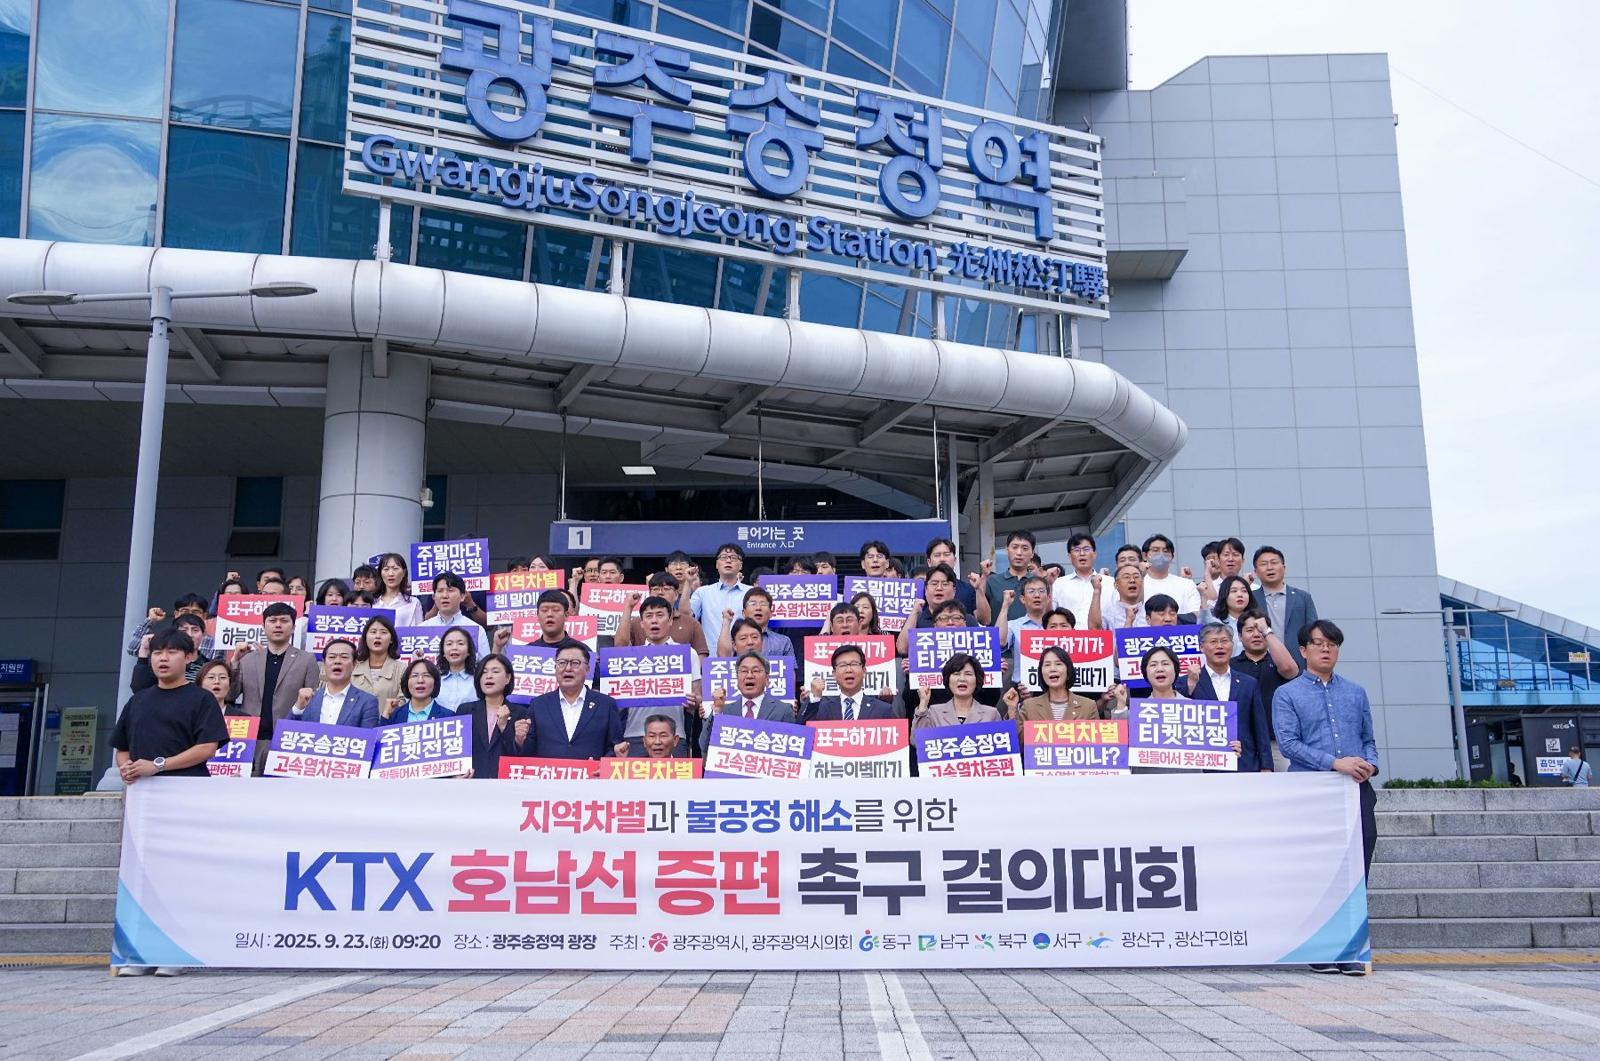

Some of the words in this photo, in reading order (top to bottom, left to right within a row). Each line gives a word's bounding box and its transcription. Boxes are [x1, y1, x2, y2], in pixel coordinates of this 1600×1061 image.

[440, 0, 1053, 241] 광주송정역
[361, 134, 797, 256] GwangjuSongjeong
[807, 216, 938, 271] Station
[576, 528, 584, 546] 1
[738, 526, 785, 540] 들어가는
[792, 526, 804, 540] 곳
[417, 542, 482, 561] 주말마다
[747, 541, 777, 549] Entrance
[418, 558, 483, 577] 티켓전쟁
[494, 572, 558, 591] 지역차별
[766, 584, 832, 599] 광주송정역
[851, 580, 917, 598] 주말마다
[510, 592, 540, 607] 말이
[916, 631, 992, 650] 주말마다
[512, 654, 556, 674] 광주송
[608, 655, 683, 675] 광주송정역
[608, 678, 684, 697] 고속열차증편
[1139, 703, 1228, 726] 주말마다
[381, 720, 463, 746] 주말마다
[720, 726, 806, 757] 광주송정역
[816, 726, 900, 747] 표구하기가
[1034, 722, 1120, 743] 지역차별
[1139, 723, 1228, 747] 티켓전쟁
[281, 731, 367, 758] 광주송정역
[381, 737, 463, 764] 티켓전쟁
[925, 732, 1012, 759] 광주송정역
[715, 751, 802, 778] 고속열차증편
[1034, 746, 1052, 766] 웬
[1055, 746, 1121, 766] 말이냐?
[1138, 750, 1180, 765] 힘들어서
[1184, 753, 1228, 767] 못살겠다
[273, 756, 361, 778] 고속열차증편
[422, 760, 463, 776] 못살겠다
[519, 800, 679, 834] 지역차별과
[686, 800, 781, 834] 불공정
[788, 799, 885, 833] 해소를
[893, 798, 957, 832] 위한
[284, 852, 434, 912] KTX
[447, 849, 638, 916] 호남선
[654, 850, 781, 916] 증편
[798, 847, 926, 916] 촉구
[942, 845, 1198, 914] 결의대회
[273, 933, 322, 949] 2025.
[324, 933, 340, 949] 9.
[391, 934, 442, 949] 09:20
[492, 934, 565, 951] 광주송정역
[567, 934, 598, 950] 광장
[672, 934, 748, 952] 광주광역시,
[751, 934, 853, 951] 광주광역시의회
[882, 934, 912, 950] 동구
[940, 933, 970, 949] 남구
[998, 933, 1028, 949] 북구
[1052, 932, 1083, 948] 서구
[1174, 930, 1248, 948] 광산구의회
